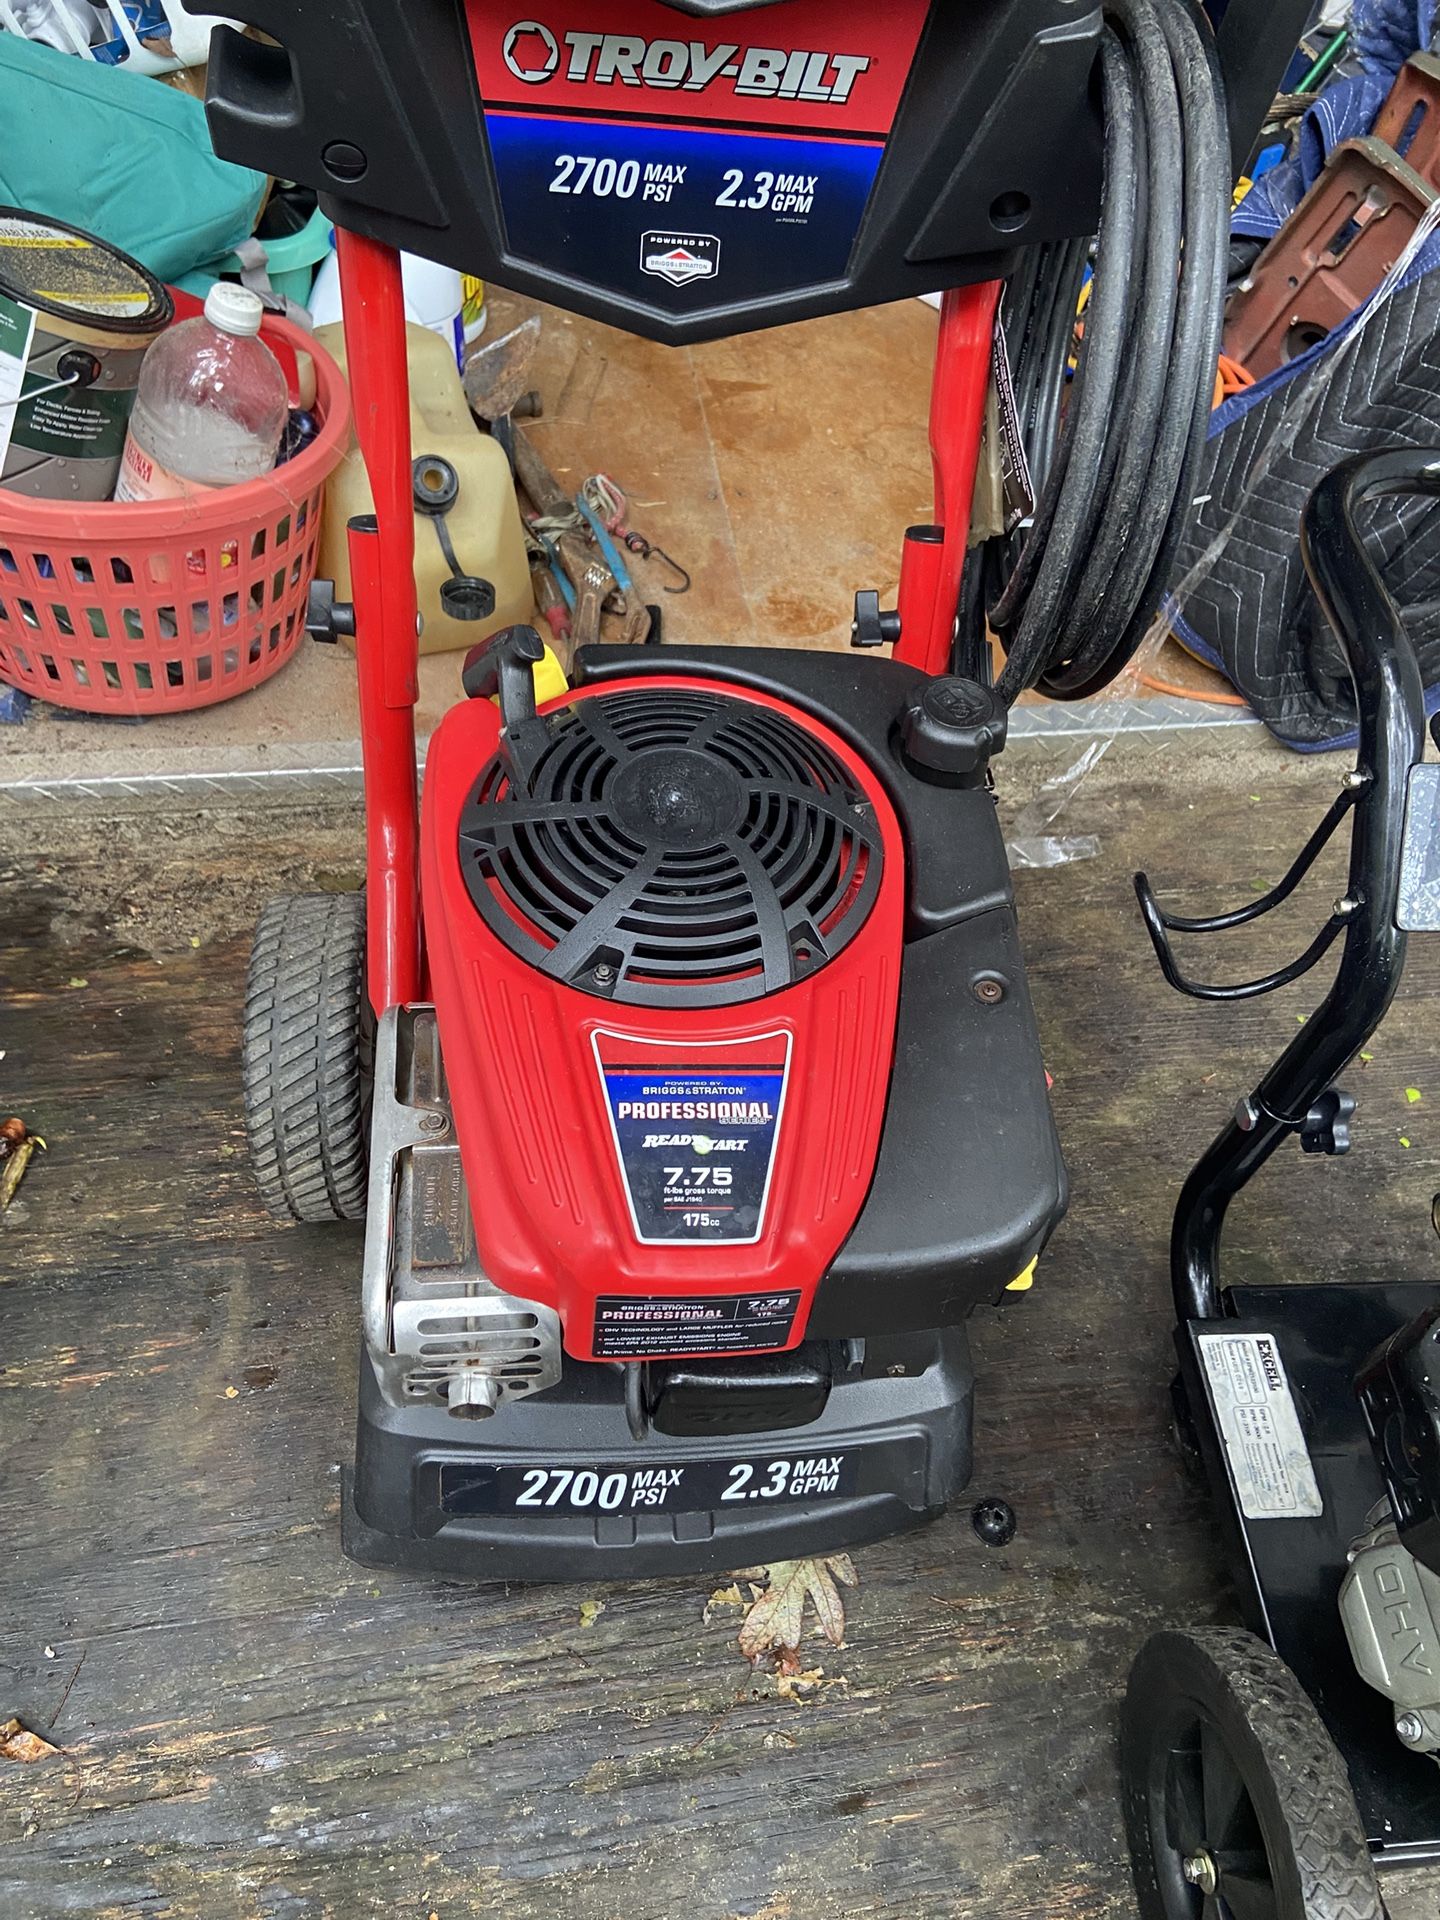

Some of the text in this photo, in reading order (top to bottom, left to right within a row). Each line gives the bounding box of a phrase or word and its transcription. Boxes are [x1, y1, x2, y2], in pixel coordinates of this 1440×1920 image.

[565, 31, 870, 103] TROY-BILT
[549, 154, 687, 198] 2700 MAX
[642, 184, 673, 202] PSI
[715, 169, 818, 209] 2.3 MAX
[770, 193, 814, 213] GPM
[650, 236, 695, 246] POWERED
[32, 415, 45, 423] Easy
[34, 406, 60, 418] Enhanced
[42, 426, 73, 438] Temperature
[618, 1102, 773, 1120] PROFESSIONAL
[663, 1167, 733, 1185] 7.75
[685, 1188, 706, 1196] gross
[707, 1187, 731, 1196] torque
[682, 1213, 720, 1226] 175cc
[602, 1309, 724, 1320] PROFESSIONAL
[1256, 1340, 1283, 1391] EXCELL
[720, 1456, 844, 1500] 2.3 MAX
[789, 1474, 839, 1495] GPM
[515, 1468, 684, 1509] 2700 MAX
[631, 1487, 668, 1507] PSI
[1373, 1562, 1433, 1676] OHV
